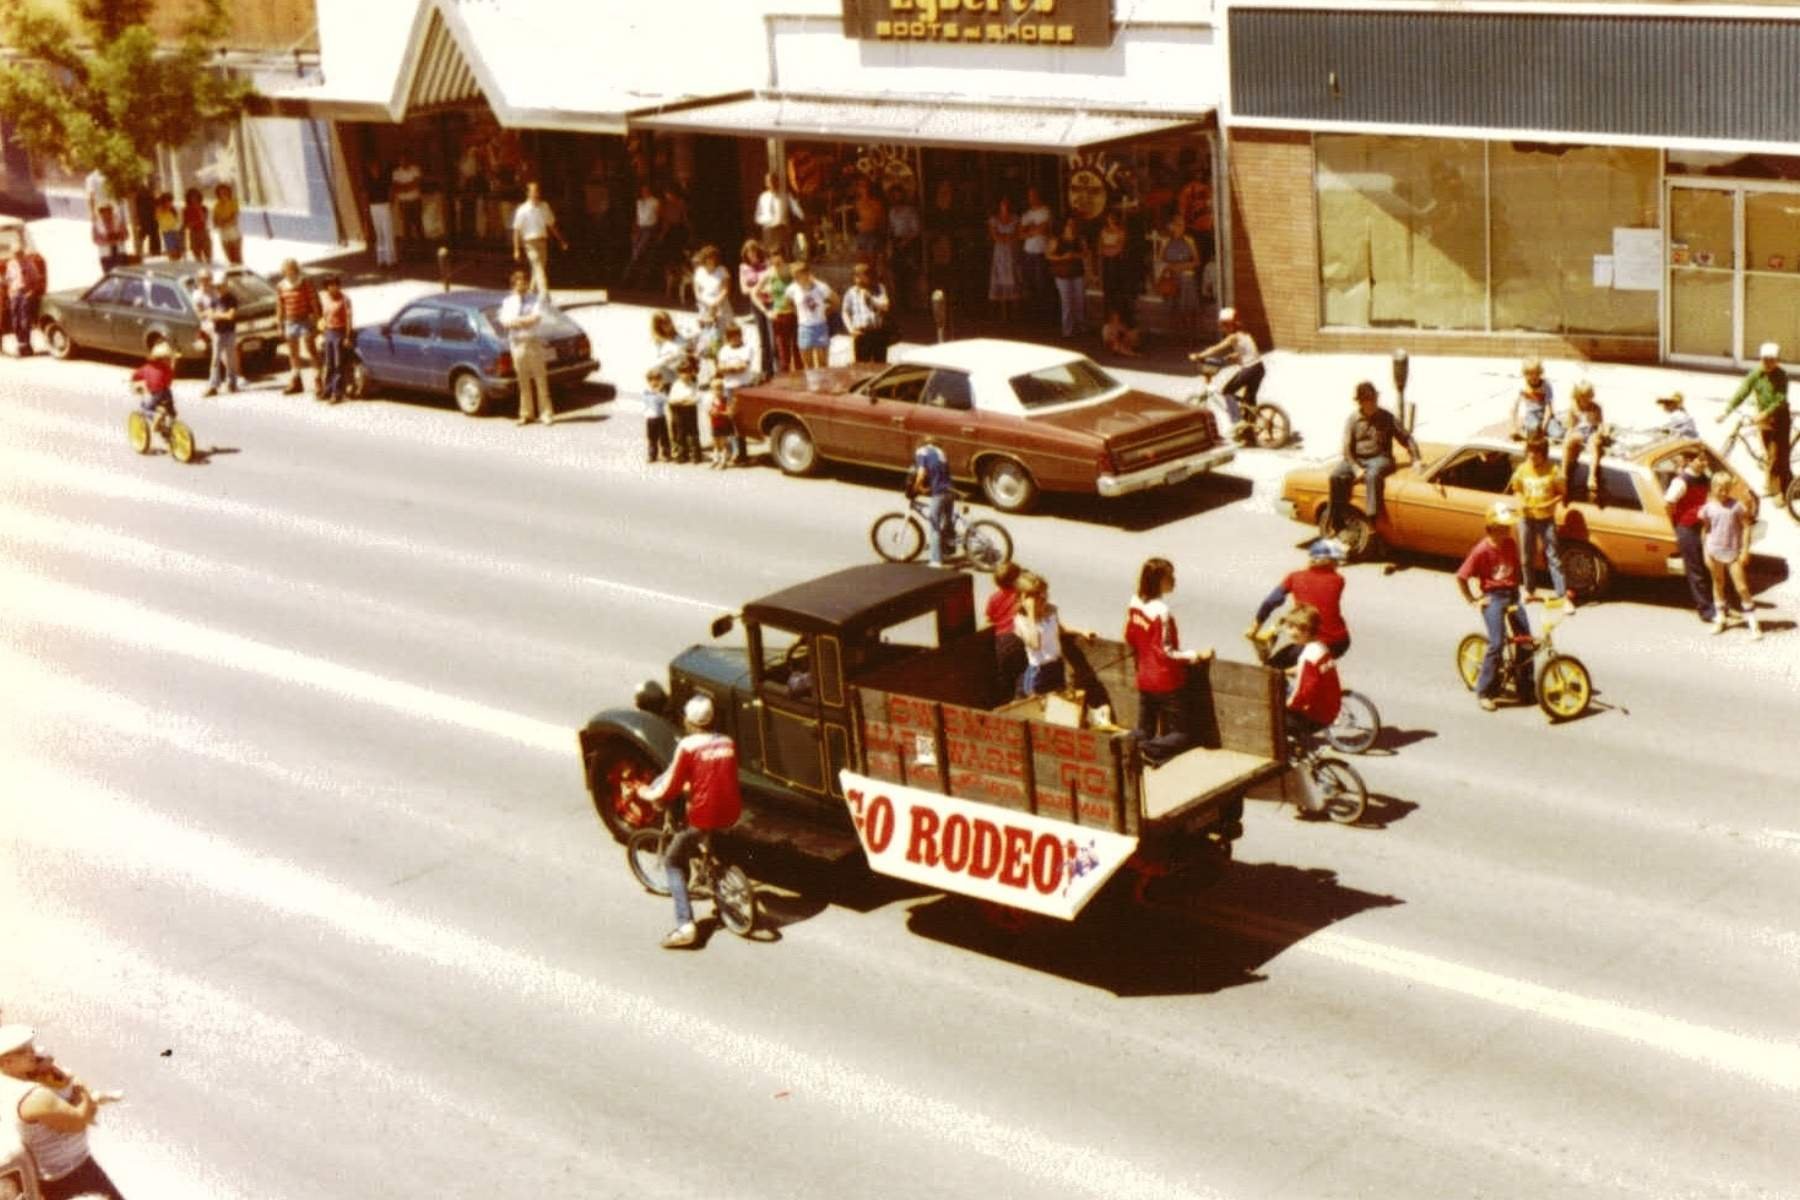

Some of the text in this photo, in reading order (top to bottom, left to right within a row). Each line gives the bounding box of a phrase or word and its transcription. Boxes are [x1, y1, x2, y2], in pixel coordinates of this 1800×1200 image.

[876, 20, 958, 38] BOOTS
[985, 23, 1074, 42] SHOES
[905, 804, 1065, 895] RODEO
